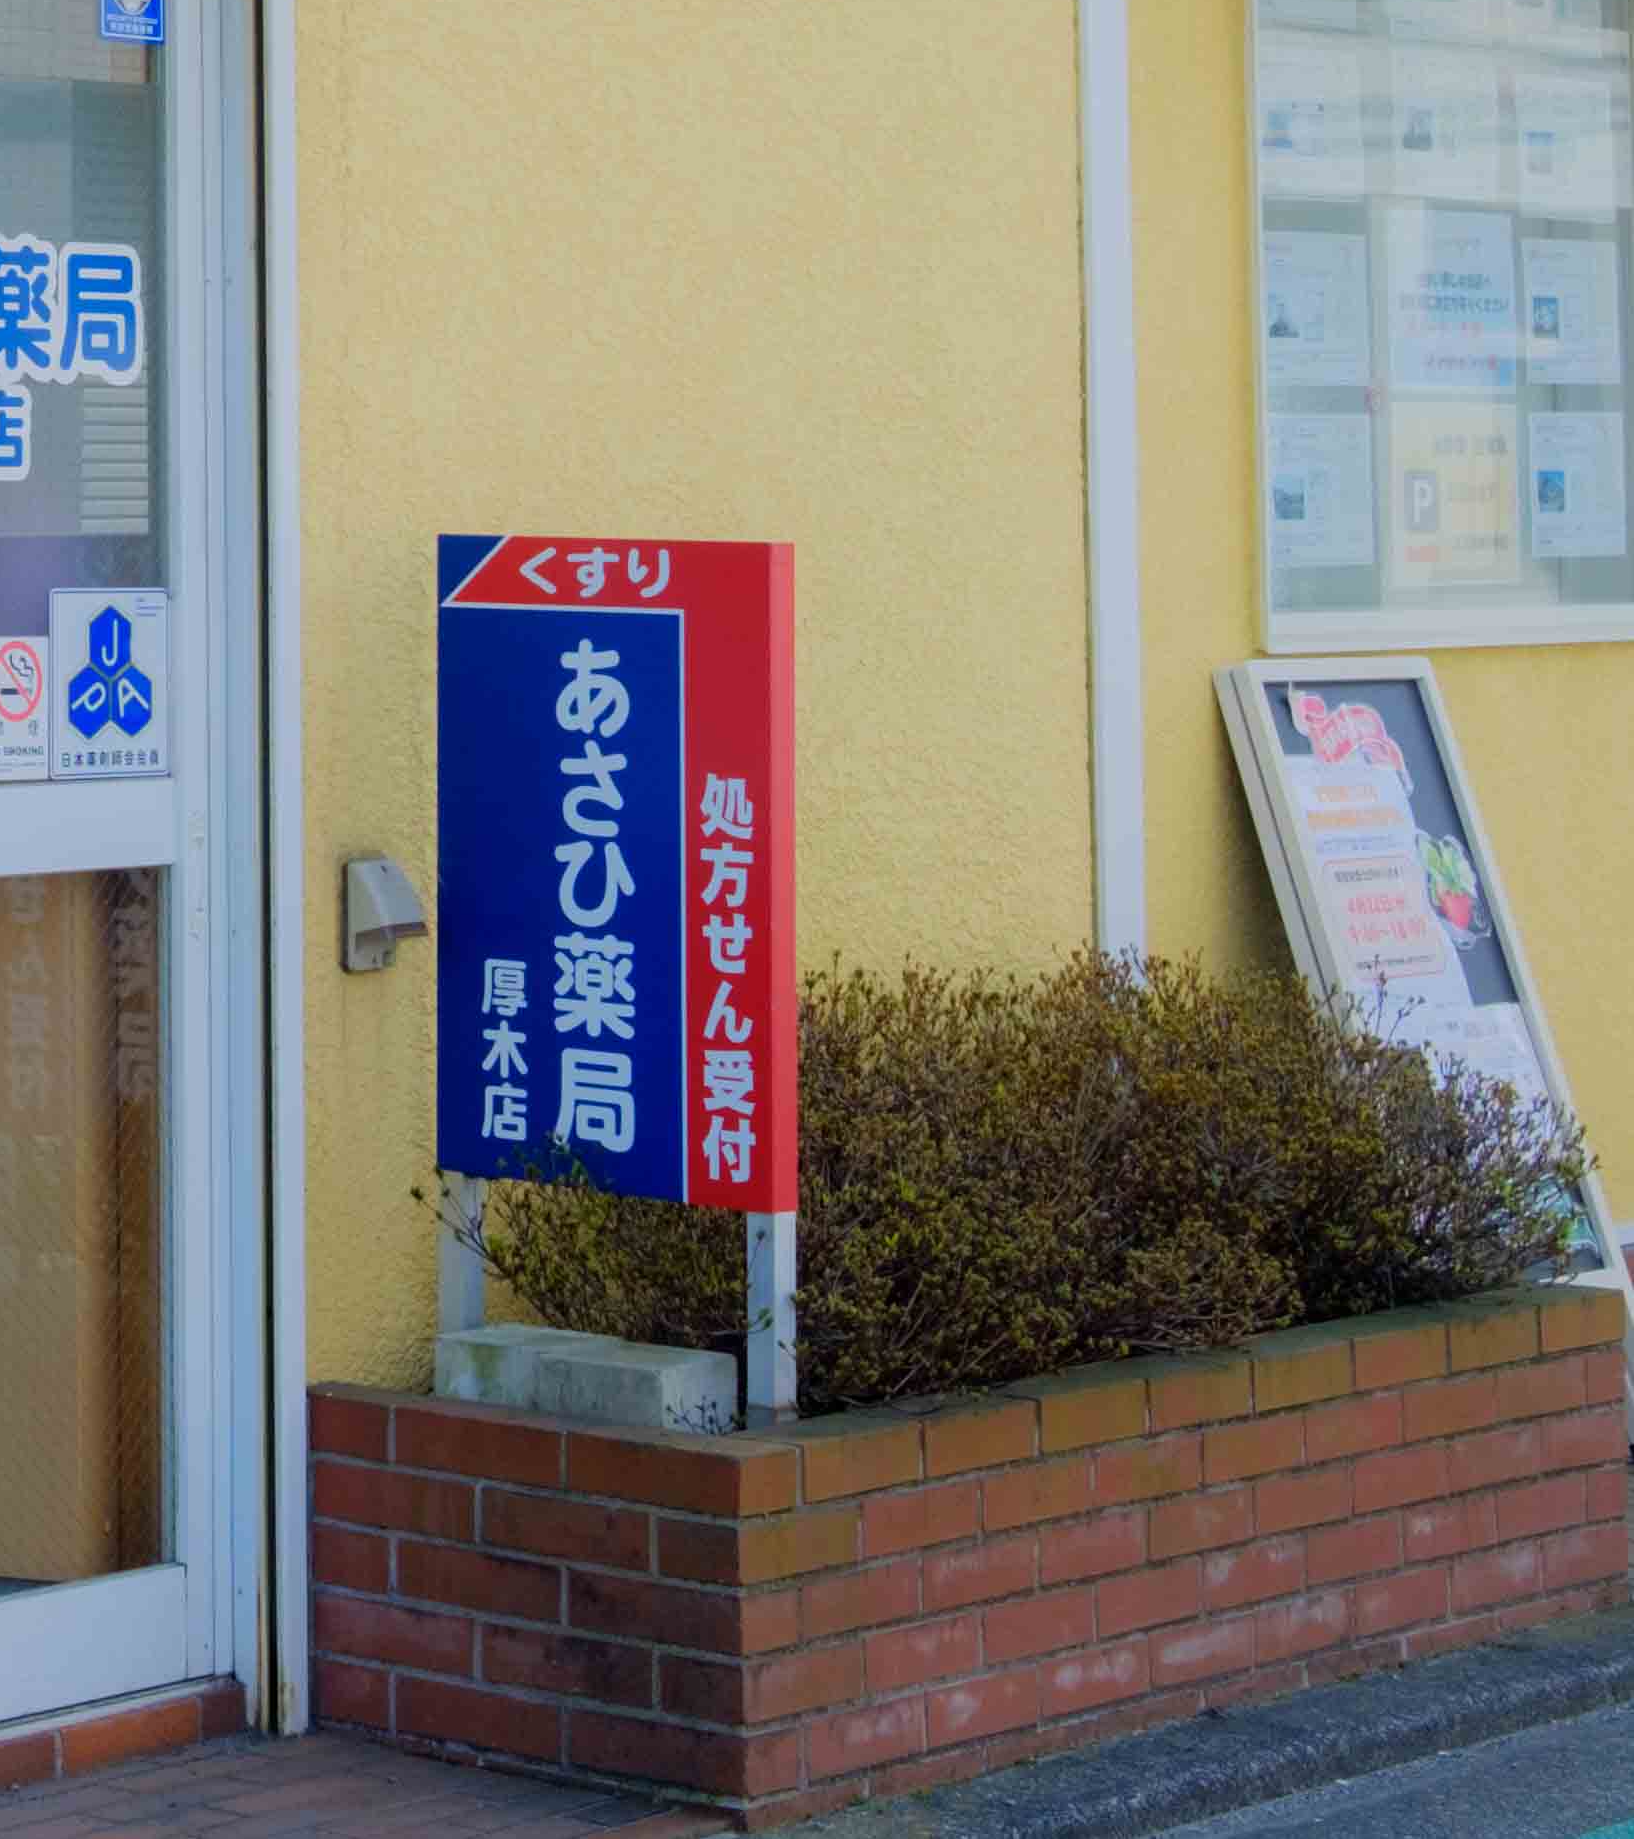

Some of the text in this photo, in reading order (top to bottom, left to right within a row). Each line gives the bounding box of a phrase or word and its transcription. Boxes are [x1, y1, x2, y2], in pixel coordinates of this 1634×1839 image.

[518, 546, 671, 599] くすり
[554, 638, 637, 1153] あさひ薬局
[699, 772, 757, 1184] 処方せん受付
[481, 958, 529, 1142] 厚木店
